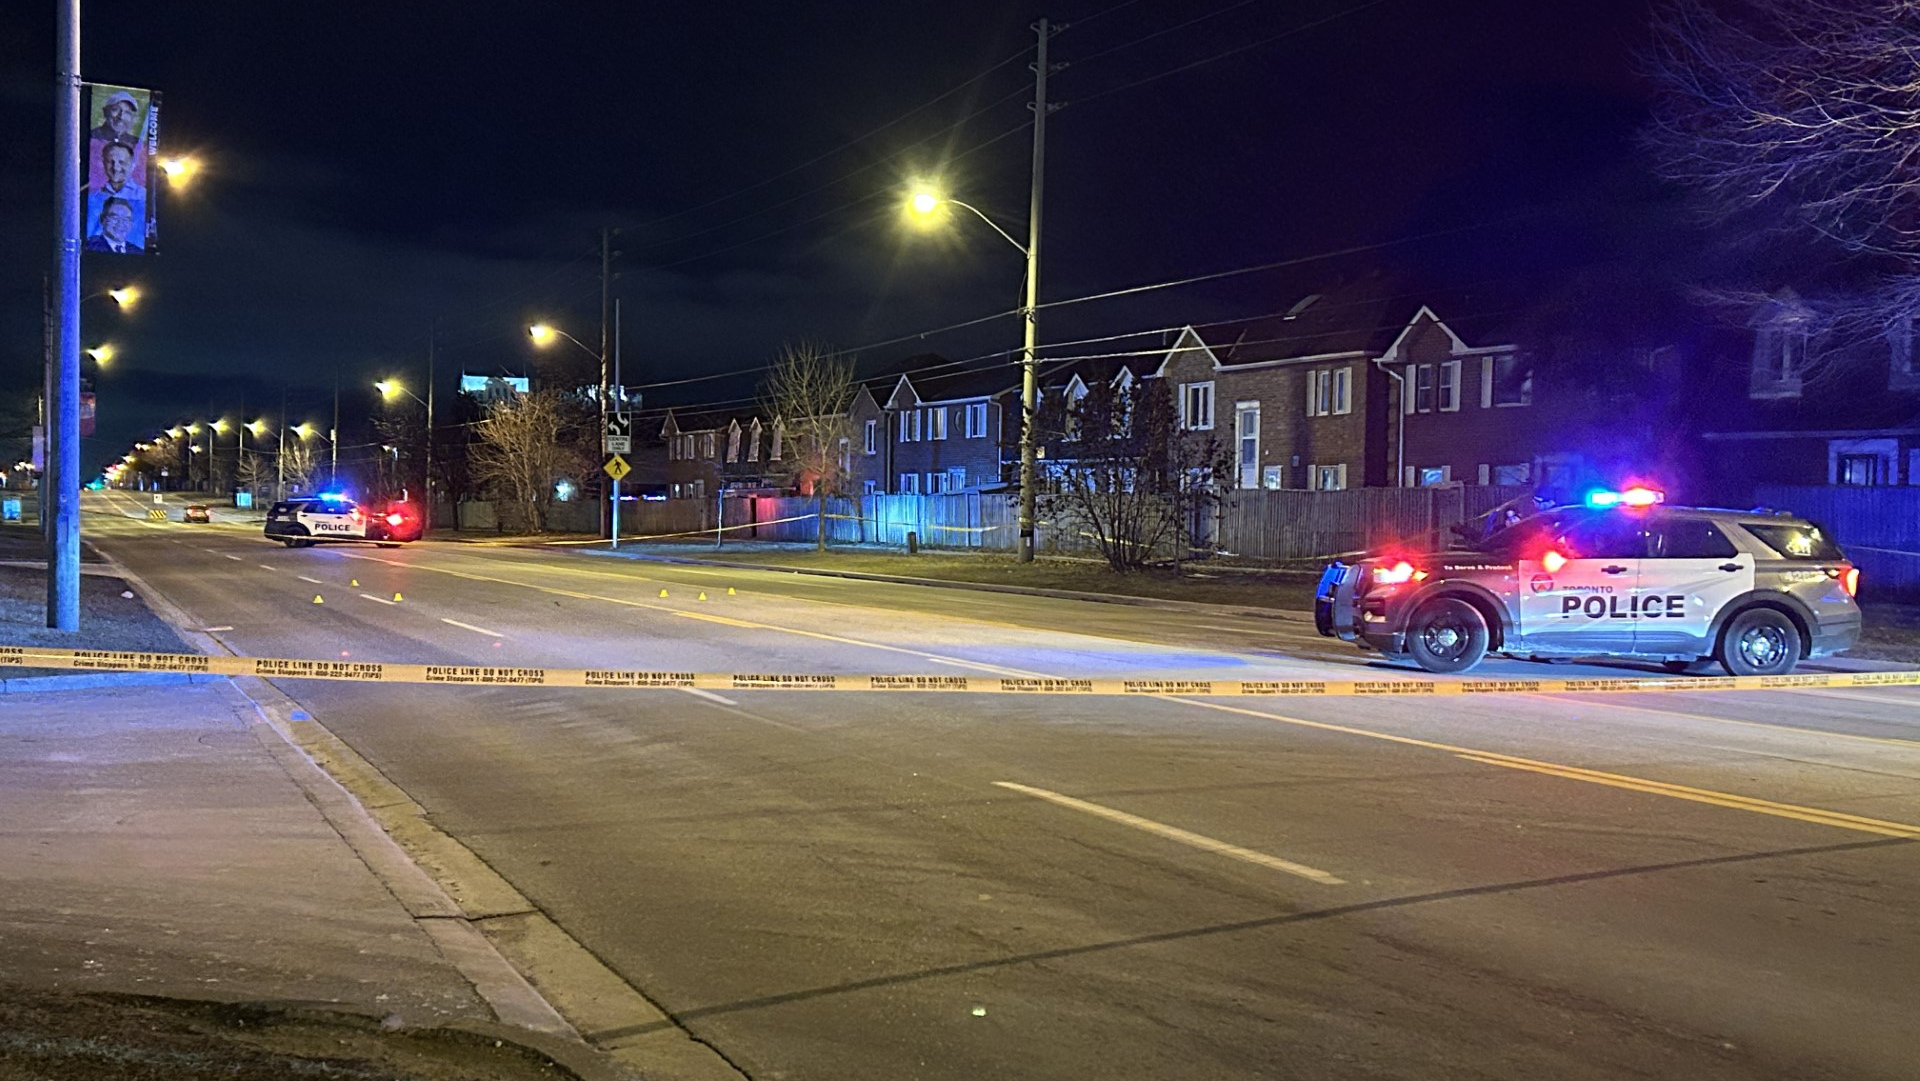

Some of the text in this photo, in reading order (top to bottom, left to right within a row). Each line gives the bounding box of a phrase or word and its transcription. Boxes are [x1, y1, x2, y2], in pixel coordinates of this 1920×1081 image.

[148, 105, 159, 156] WELCOME
[314, 523, 351, 531] POLICE
[1562, 595, 1684, 618] POLICE
[113, 653, 135, 661] LINE
[140, 654, 152, 662] DO
[157, 655, 173, 663] NOT
[178, 656, 208, 664] CROSS
[256, 660, 382, 672] POLICE LINE DO NOT CROSS
[427, 667, 457, 675] POLICE
[499, 668, 514, 676] NOT
